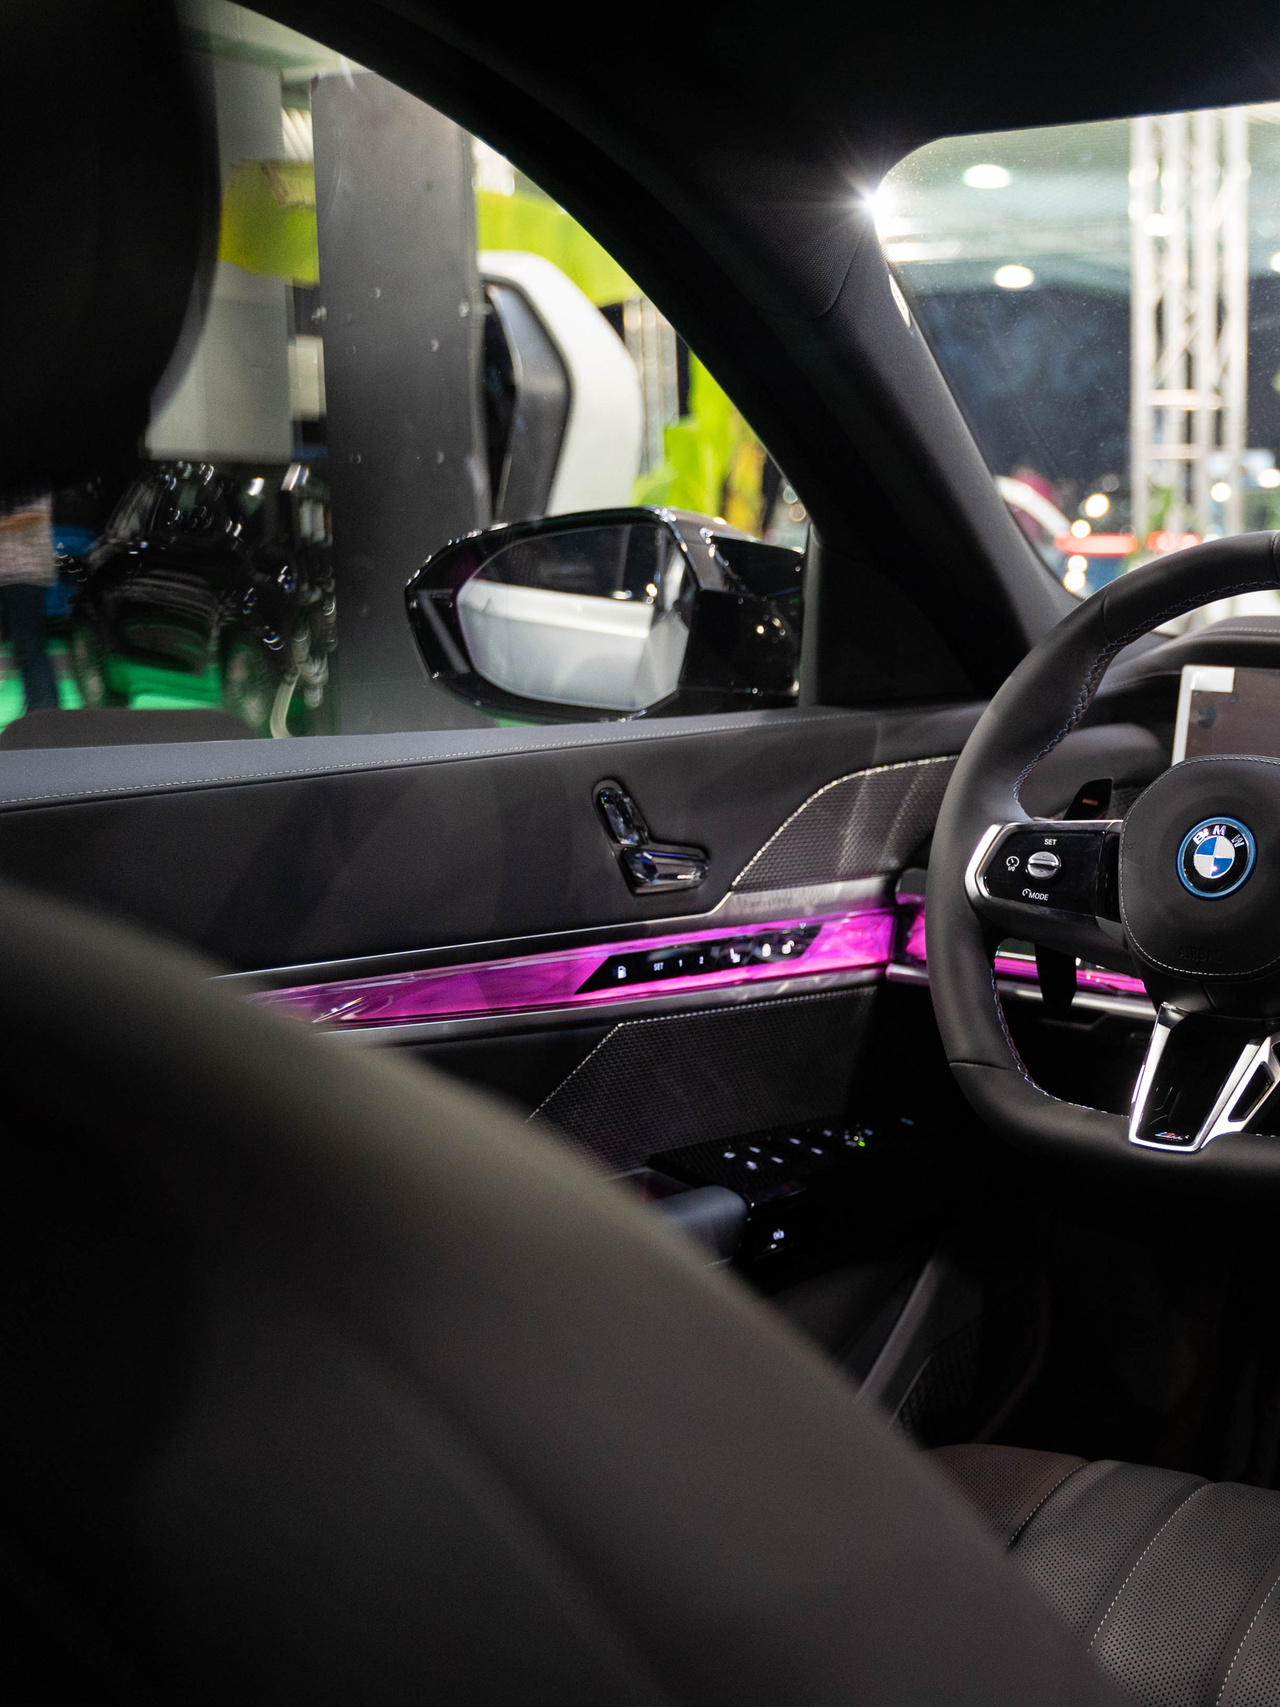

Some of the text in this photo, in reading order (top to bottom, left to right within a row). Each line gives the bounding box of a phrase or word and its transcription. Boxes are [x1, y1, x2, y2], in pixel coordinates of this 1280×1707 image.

[1193, 824, 1245, 848] BMW
[1044, 838, 1057, 846] SET
[1028, 891, 1049, 901] MODE
[653, 962, 664, 971] SET
